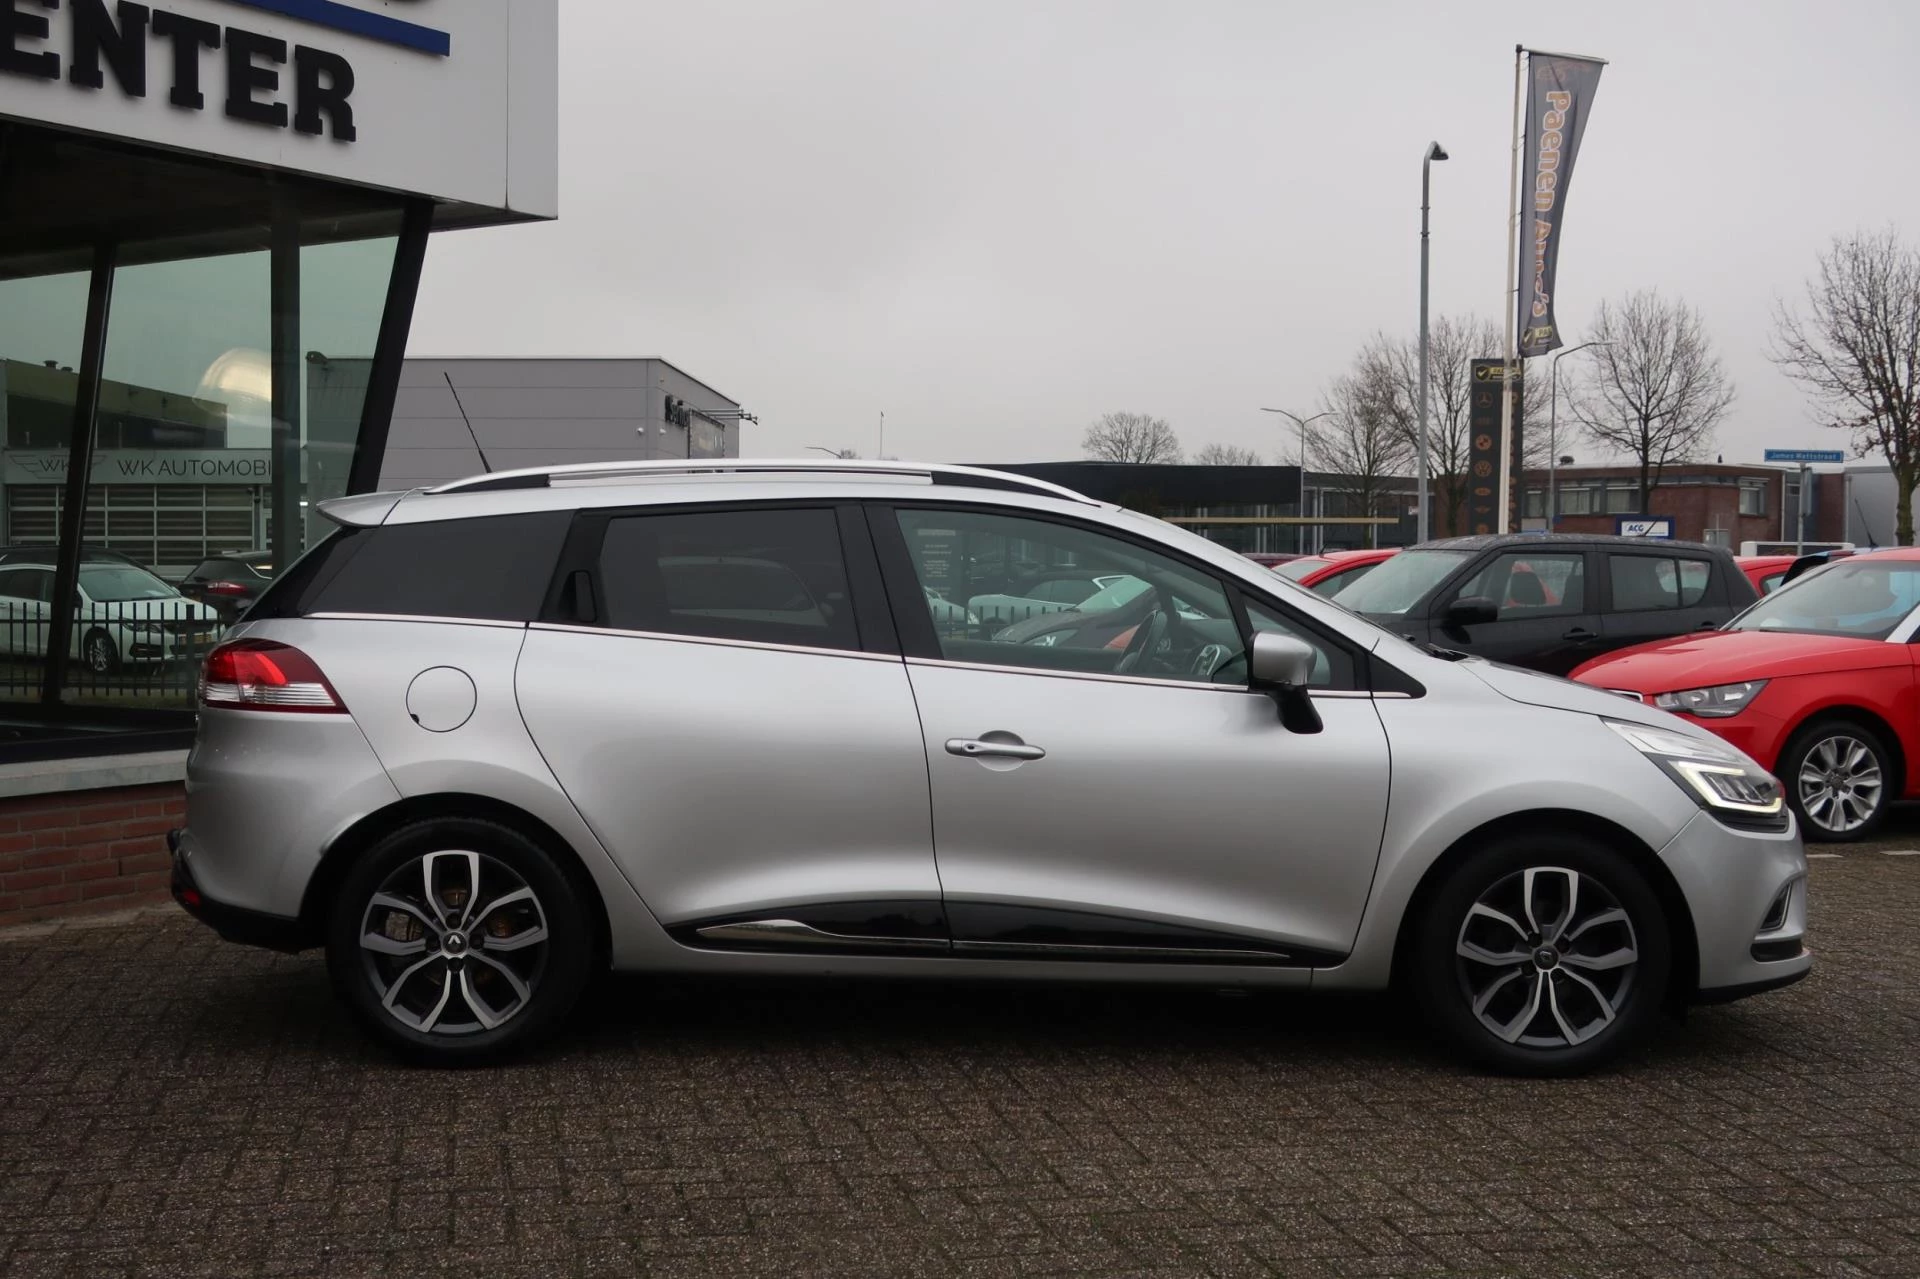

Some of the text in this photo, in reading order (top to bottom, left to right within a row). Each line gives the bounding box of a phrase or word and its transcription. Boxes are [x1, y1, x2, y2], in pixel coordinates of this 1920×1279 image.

[1534, 90, 1572, 213] Paenen
[117, 459, 154, 476] WK
[1628, 523, 1645, 533] ACG
